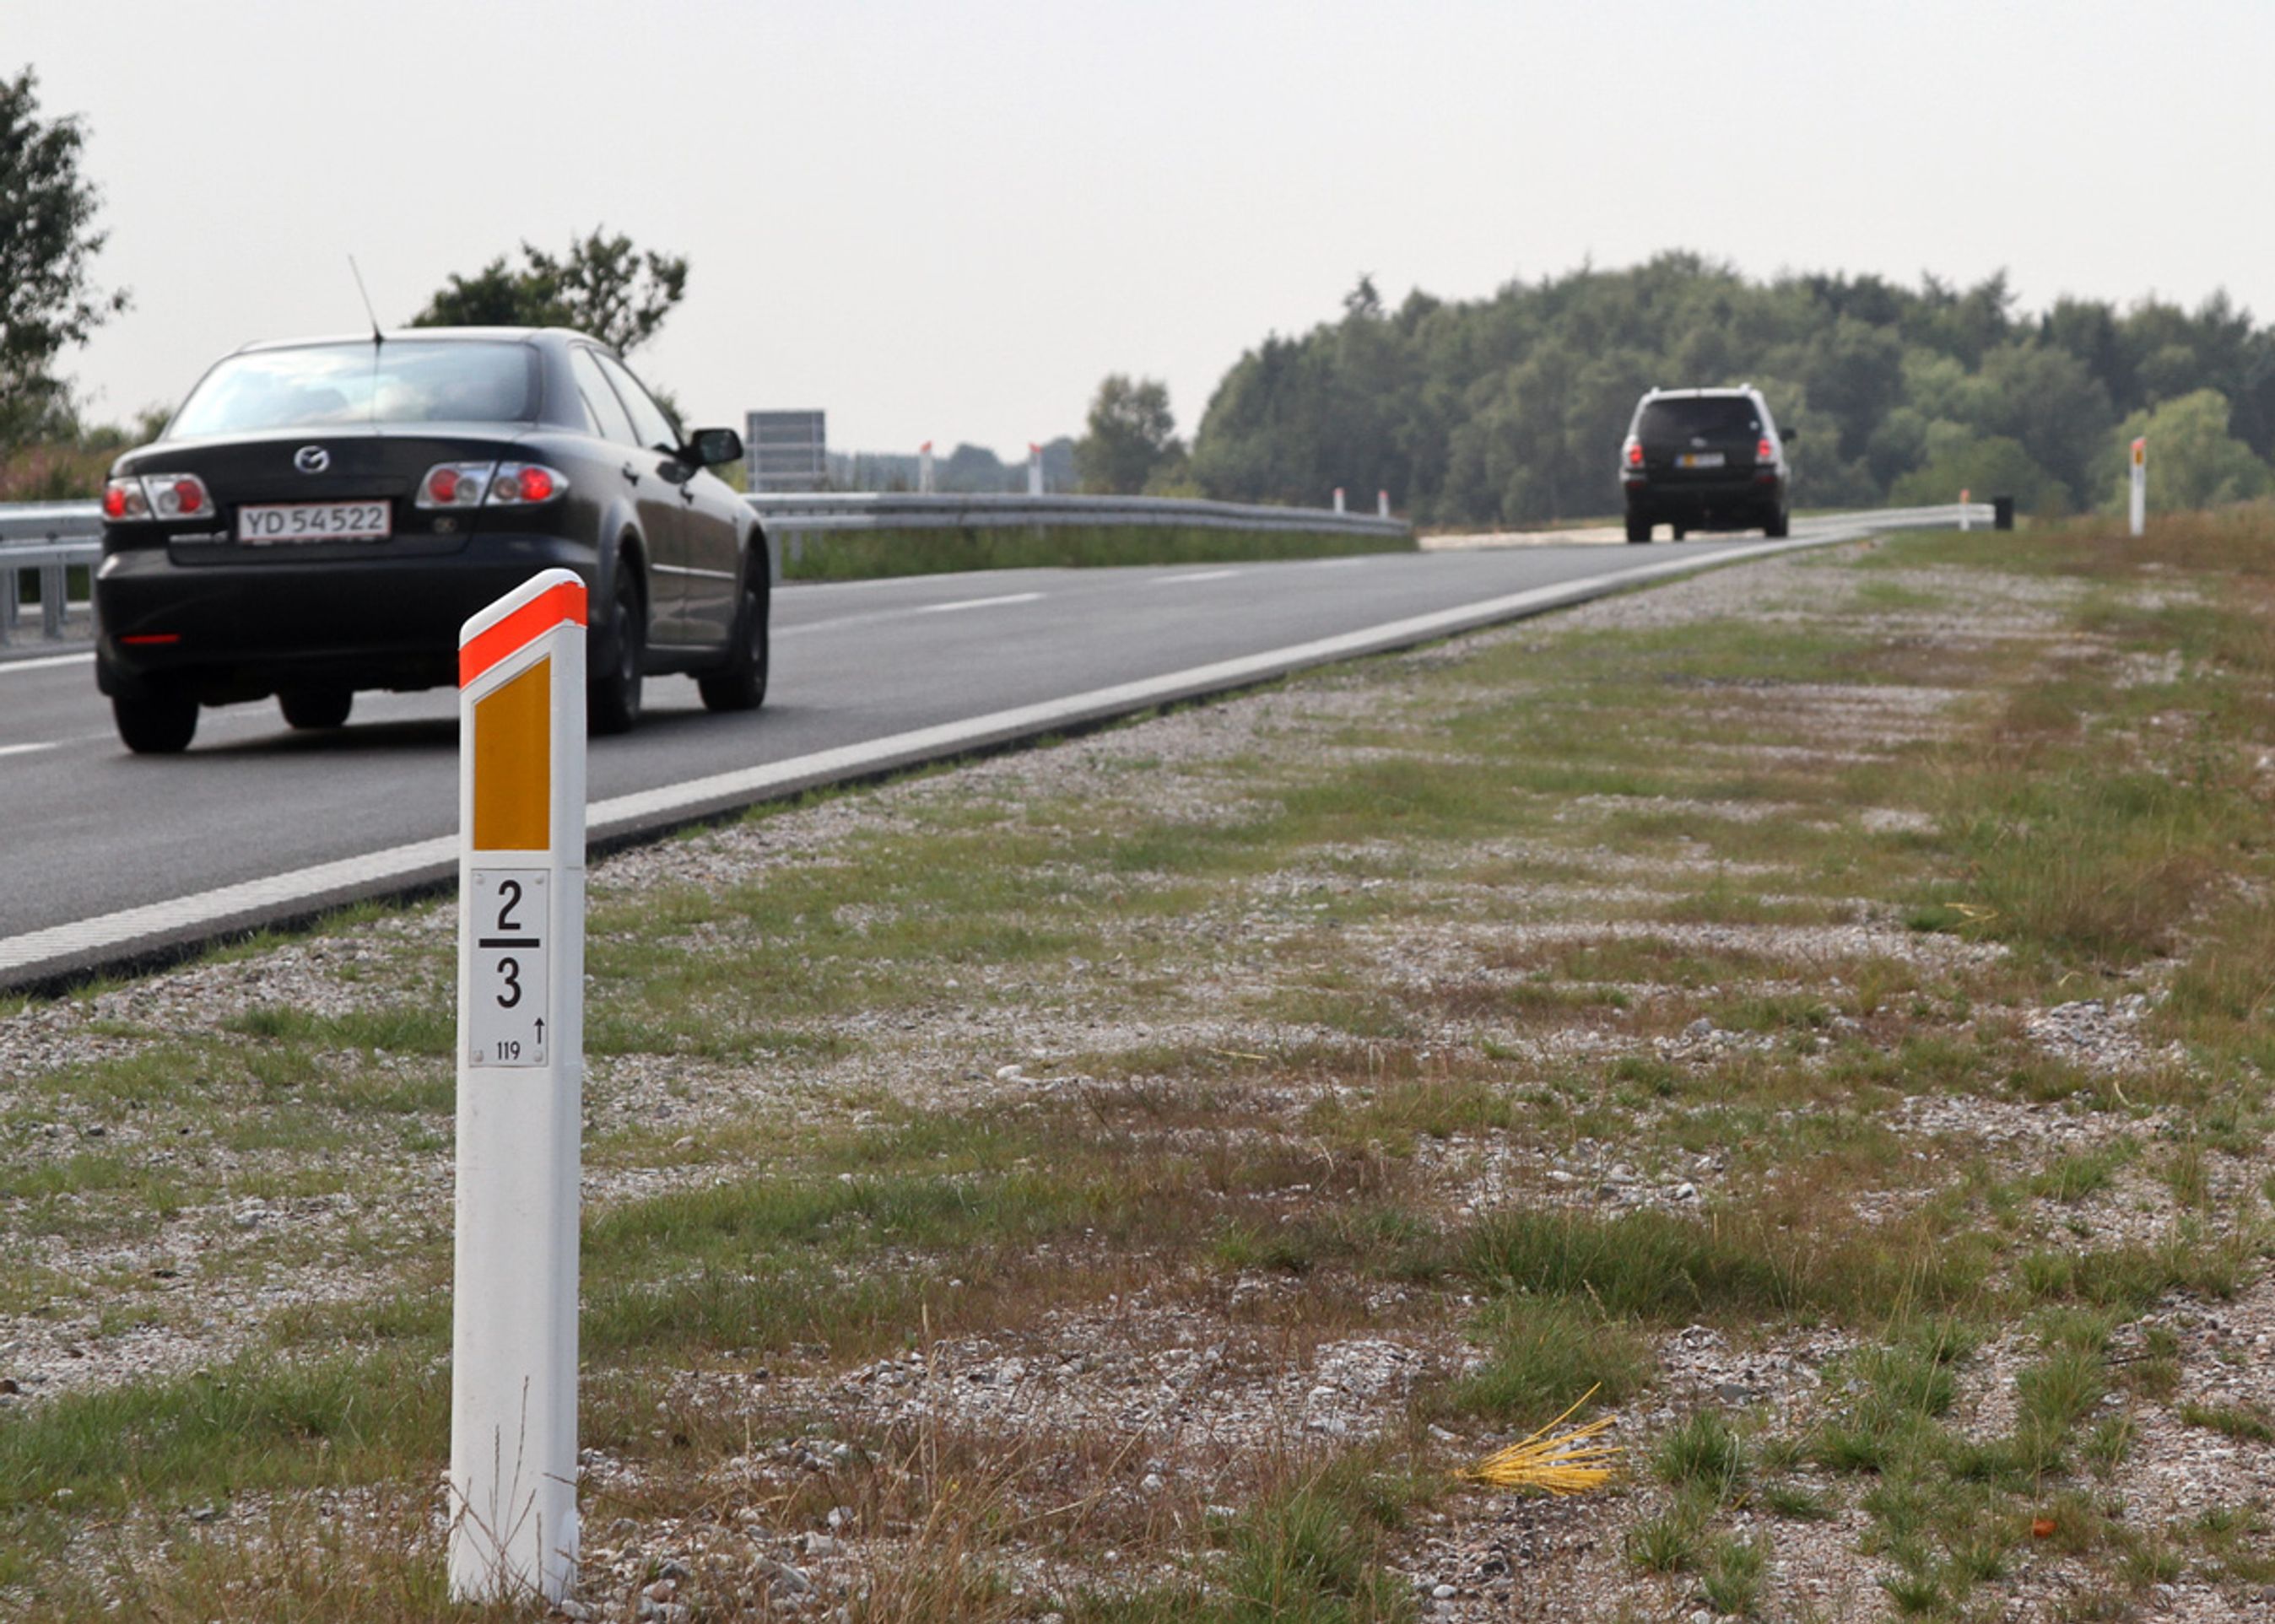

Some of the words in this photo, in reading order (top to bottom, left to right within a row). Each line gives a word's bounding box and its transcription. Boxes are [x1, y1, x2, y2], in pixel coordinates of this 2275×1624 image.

[498, 879, 521, 930] 2
[496, 957, 521, 1008] 3
[497, 1040, 521, 1060] 119
